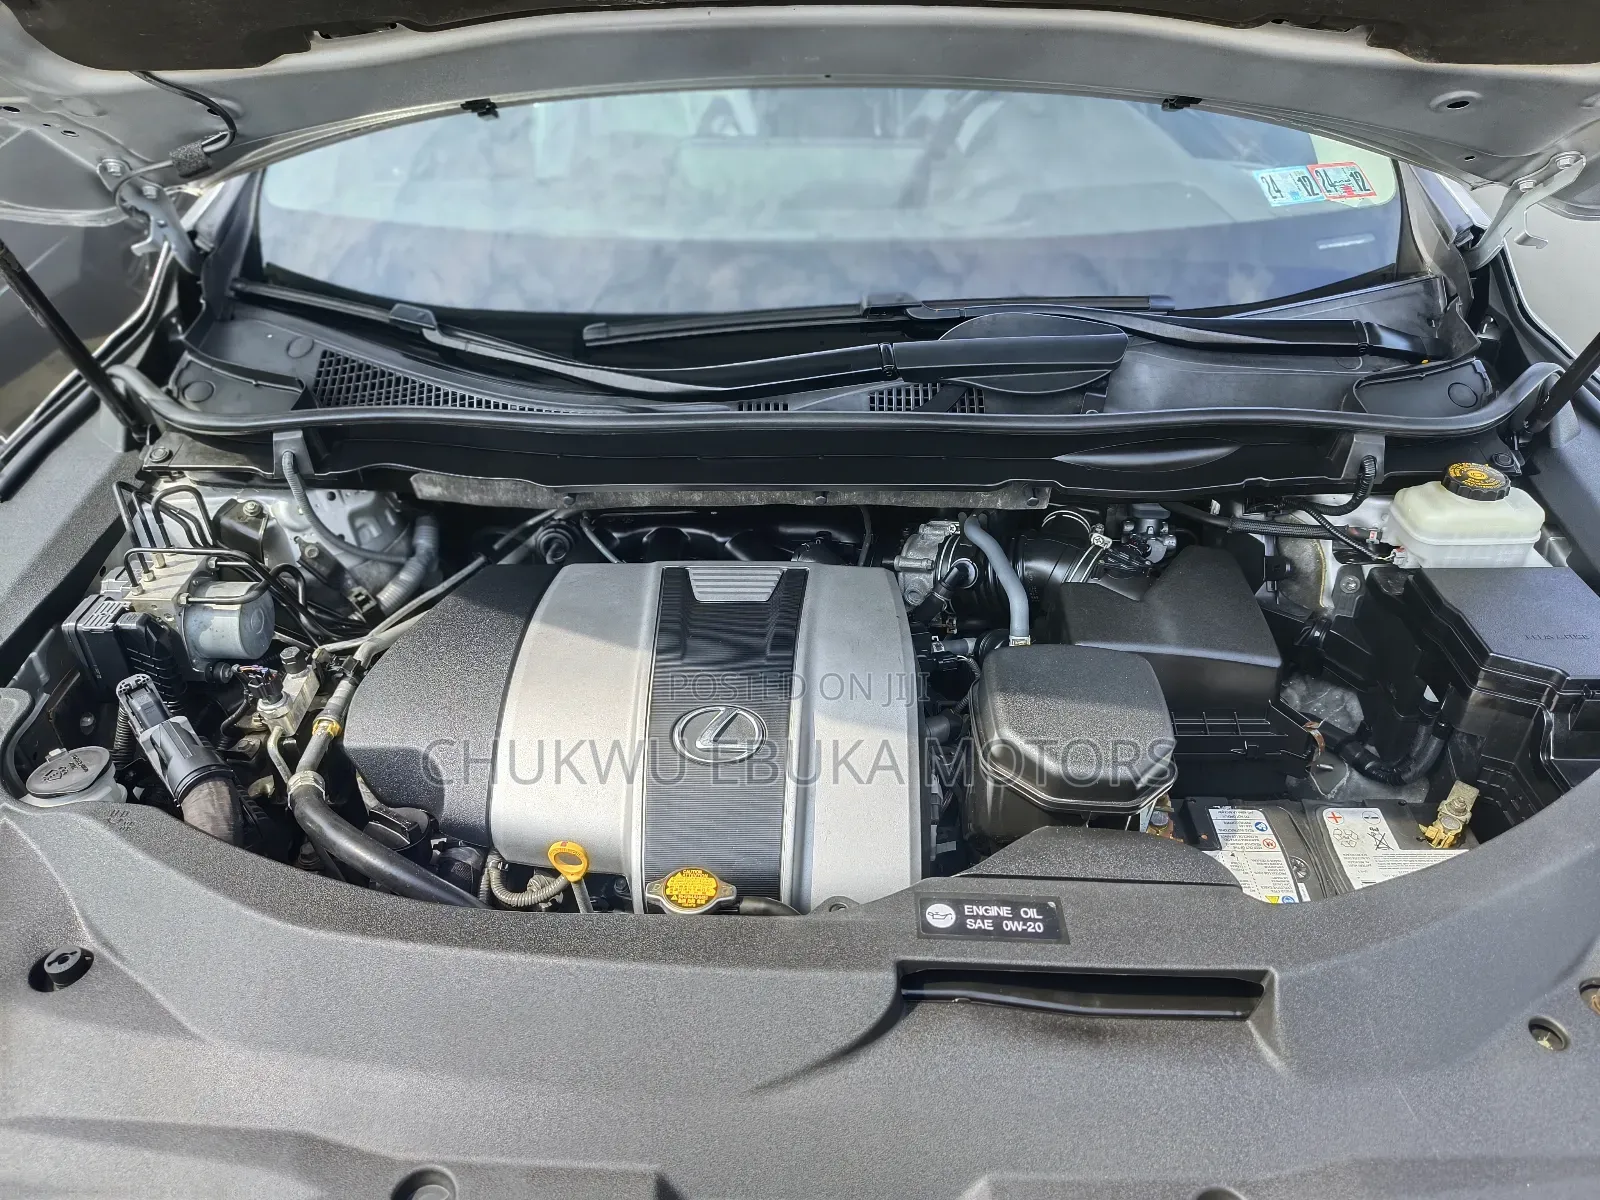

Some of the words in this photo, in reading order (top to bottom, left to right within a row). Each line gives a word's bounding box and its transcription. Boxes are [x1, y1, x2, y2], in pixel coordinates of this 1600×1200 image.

[1260, 174, 1284, 199] 24
[1297, 175, 1319, 197] 12
[1314, 169, 1337, 194] 24
[1350, 171, 1371, 192] 12
[964, 904, 1013, 918] ENGINE
[1020, 907, 1043, 919] OIL
[966, 918, 994, 930] SAE
[1002, 920, 1044, 933] 0W-20
